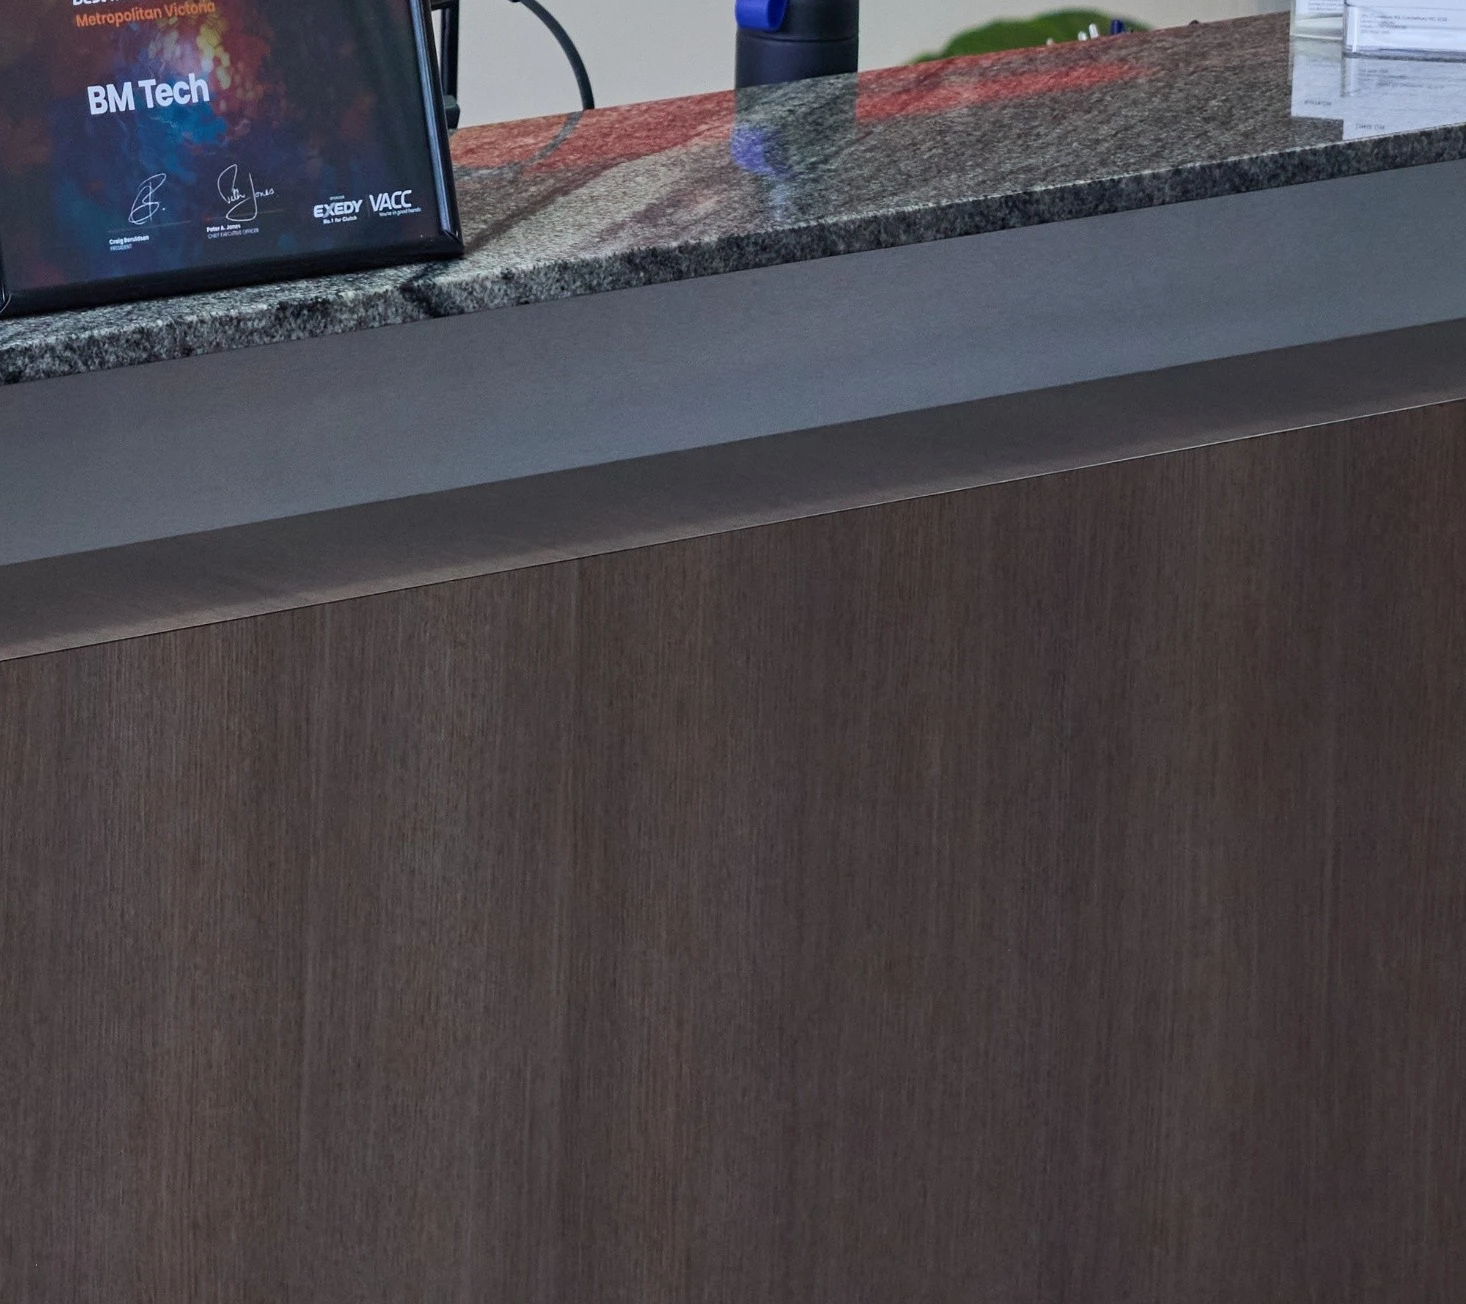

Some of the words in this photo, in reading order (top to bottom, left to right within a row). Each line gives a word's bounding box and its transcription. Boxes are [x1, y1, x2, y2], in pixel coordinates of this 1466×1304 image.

[75, 5, 162, 28] Metropolitan
[164, 0, 216, 19] Victoria
[86, 81, 136, 115] BM
[138, 72, 210, 109] Tech
[313, 199, 363, 218] EXEDY
[369, 189, 413, 212] VACC
[206, 225, 219, 233] Peter
[226, 222, 242, 231] Jones
